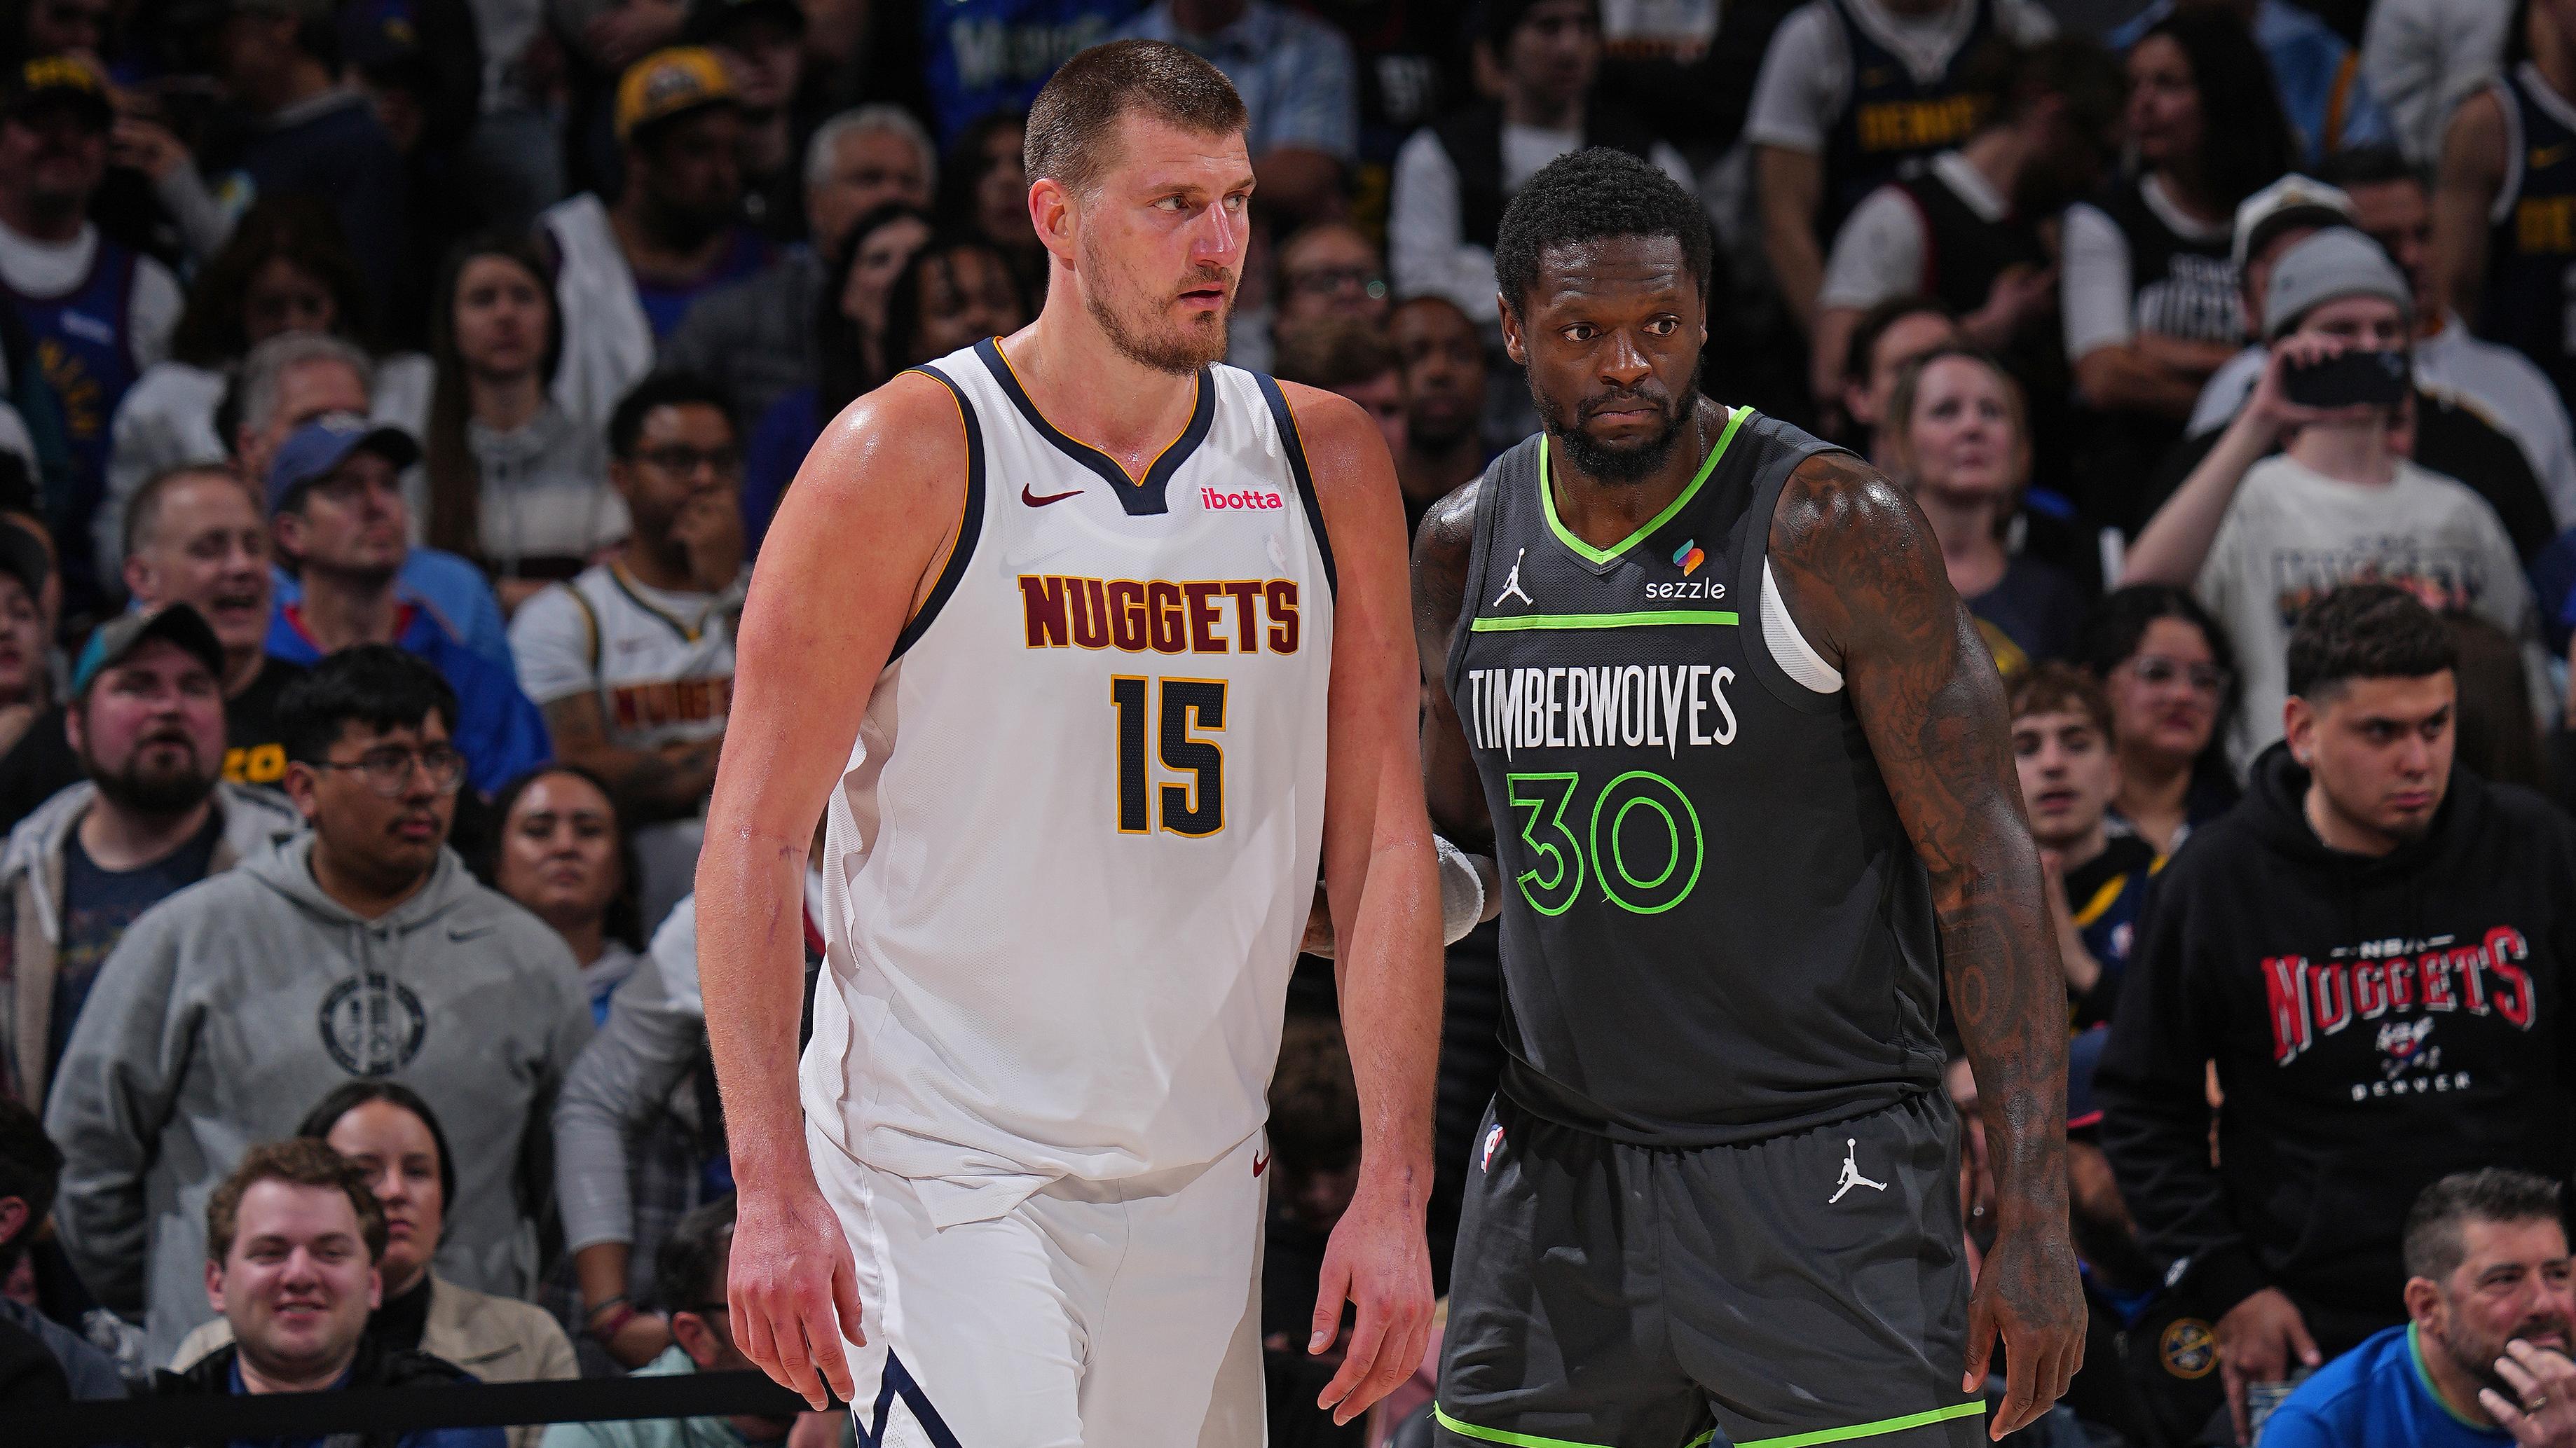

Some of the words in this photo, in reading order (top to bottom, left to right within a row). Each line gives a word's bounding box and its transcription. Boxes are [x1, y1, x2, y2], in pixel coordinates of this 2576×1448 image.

[1200, 487, 1283, 509] ibotta
[1018, 574, 1300, 655] NUGGETS
[1645, 577, 1726, 599] sezzle
[1110, 674, 1228, 839] 15
[1469, 665, 1738, 763] TIMBERWOLVES
[1506, 771, 1704, 916] 30
[2260, 924, 2537, 1068] NUGGETS
[2351, 1070, 2472, 1102] DENVER
